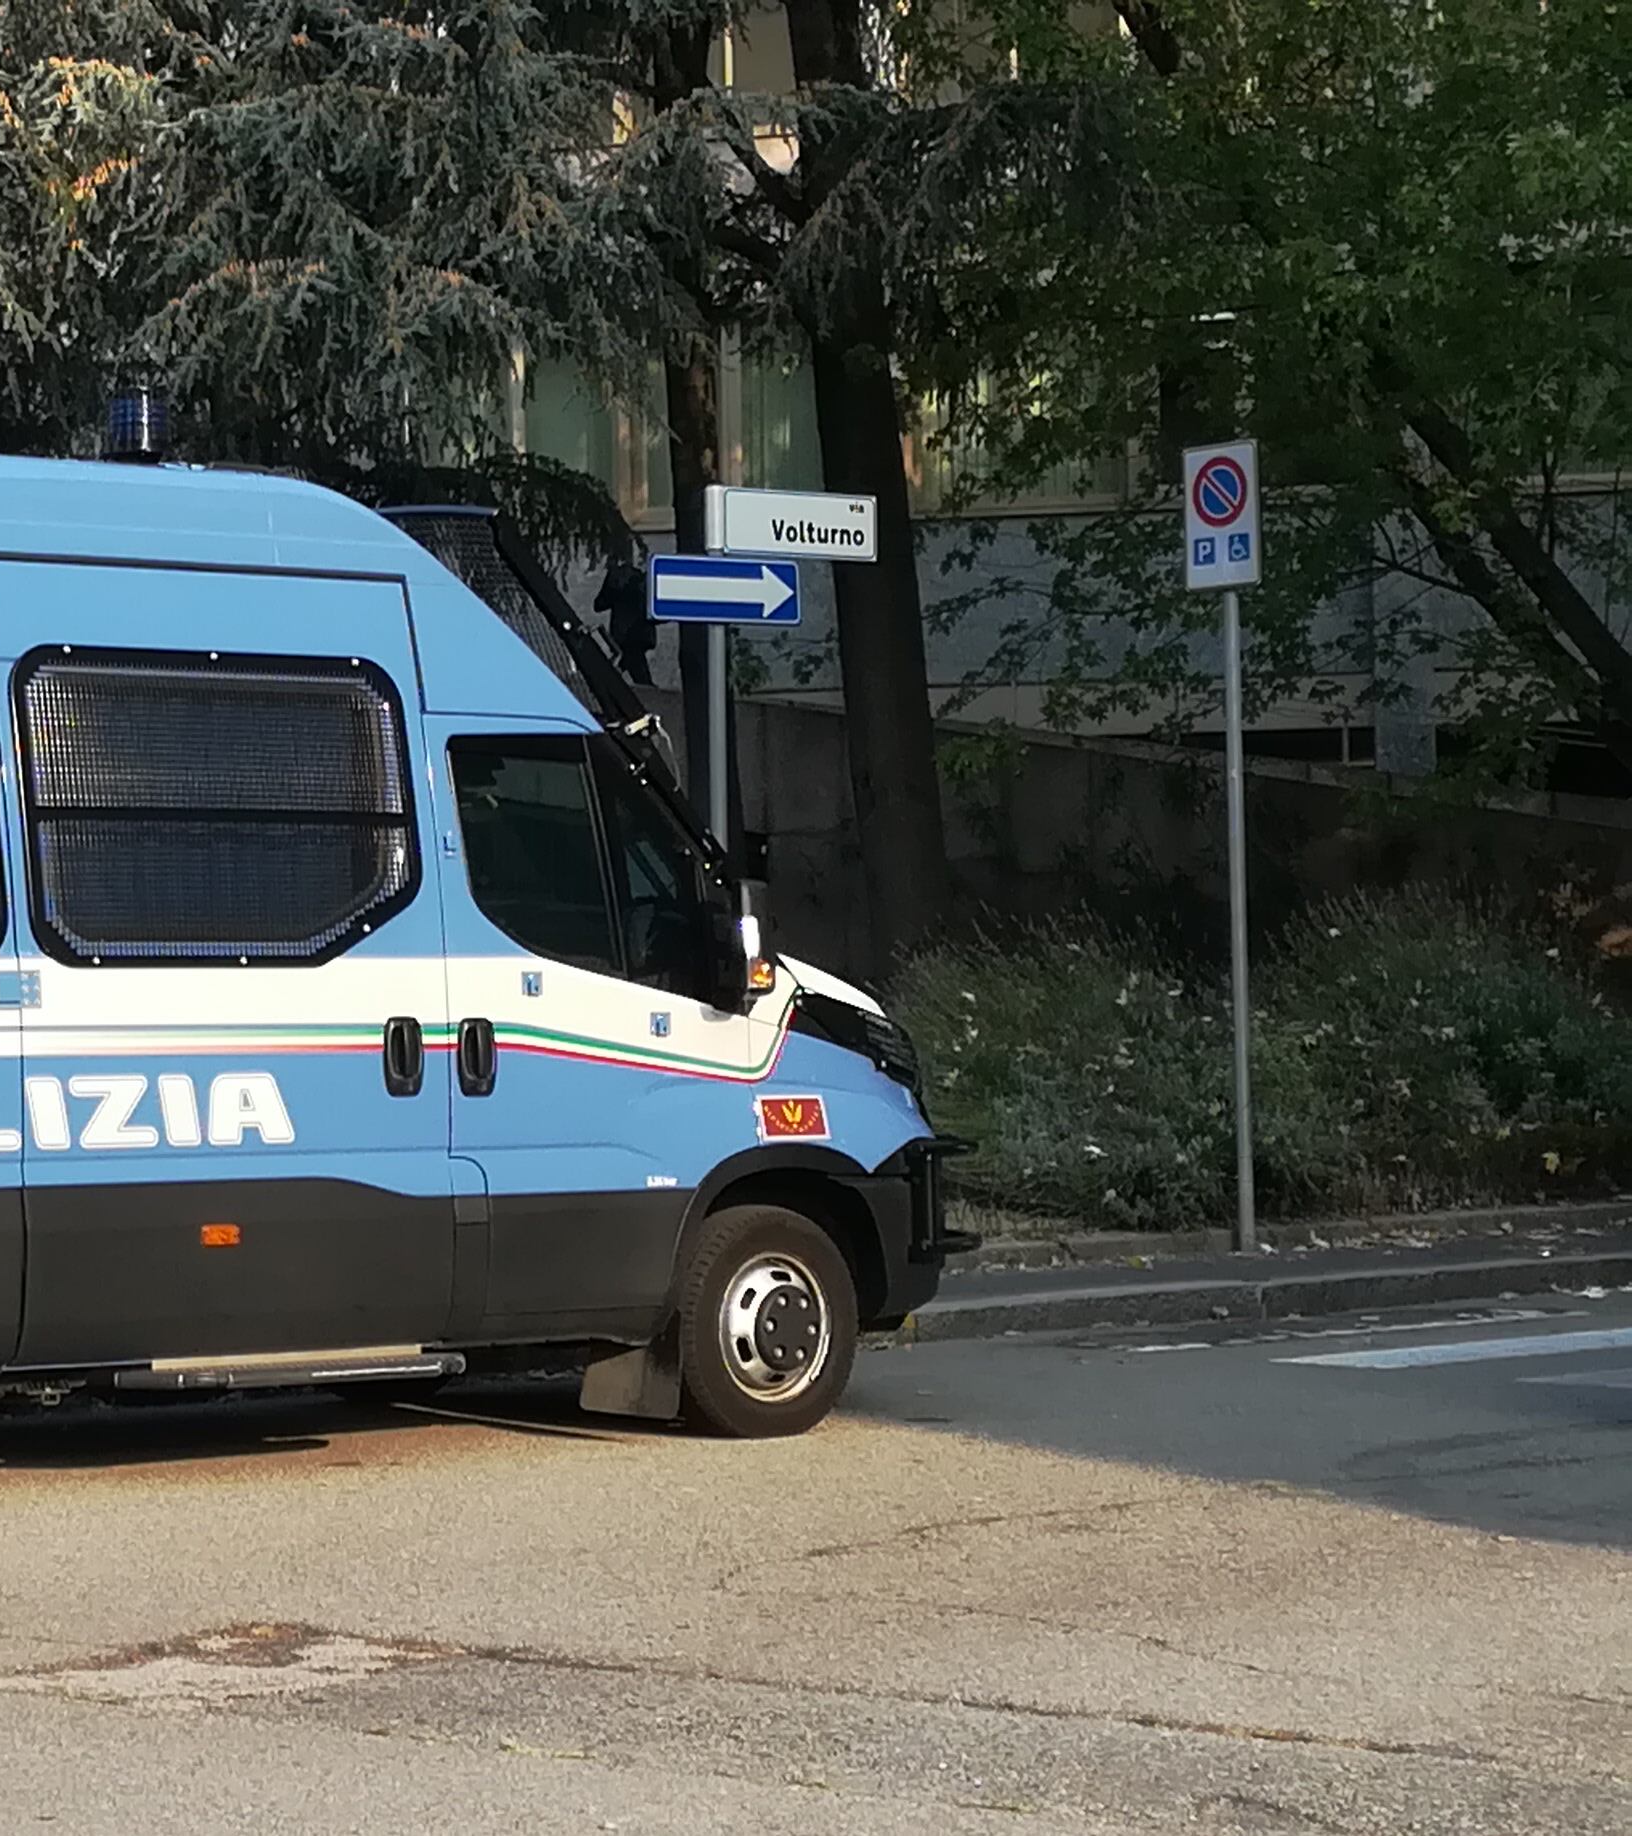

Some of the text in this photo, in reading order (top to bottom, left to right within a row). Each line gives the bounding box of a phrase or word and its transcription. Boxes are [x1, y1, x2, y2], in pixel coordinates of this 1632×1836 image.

[849, 502, 865, 514] via
[772, 519, 865, 546] Volturno
[1198, 541, 1211, 562] P
